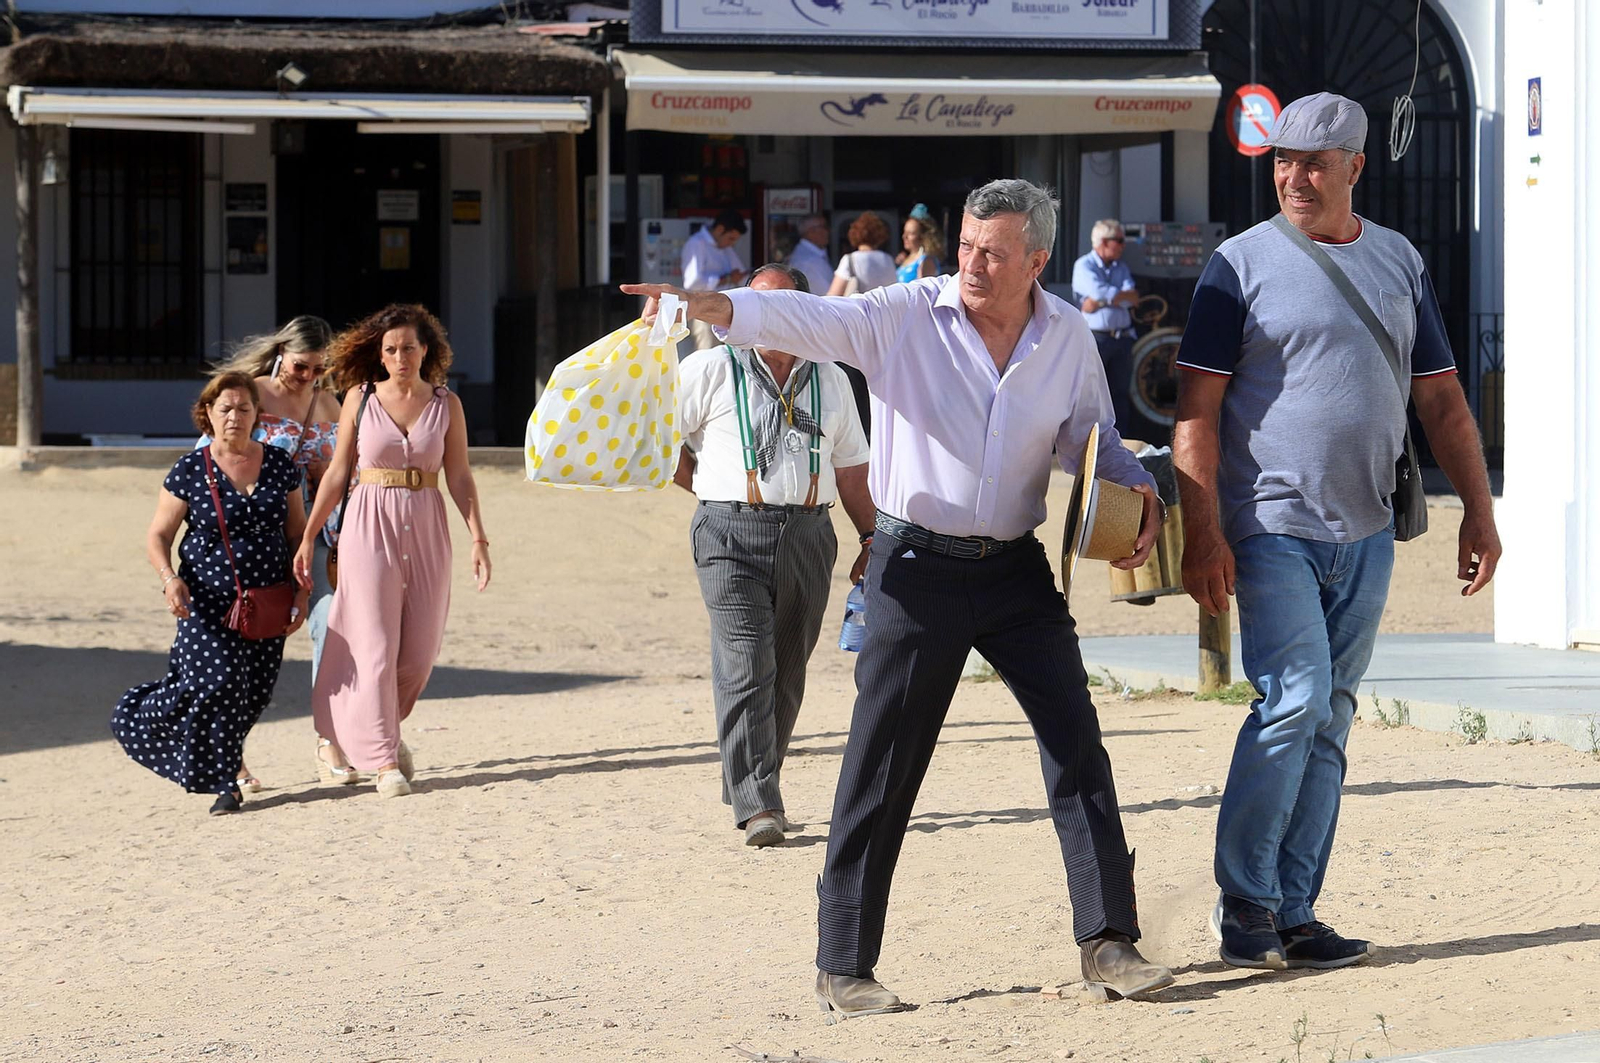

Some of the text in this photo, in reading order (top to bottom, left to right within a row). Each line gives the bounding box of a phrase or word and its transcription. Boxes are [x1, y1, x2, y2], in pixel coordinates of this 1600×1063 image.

[917, 9, 927, 18] El
[651, 91, 753, 113] Cruzcampo
[896, 93, 1015, 127] La Canaliega
[1094, 95, 1193, 113] Cruzcampo
